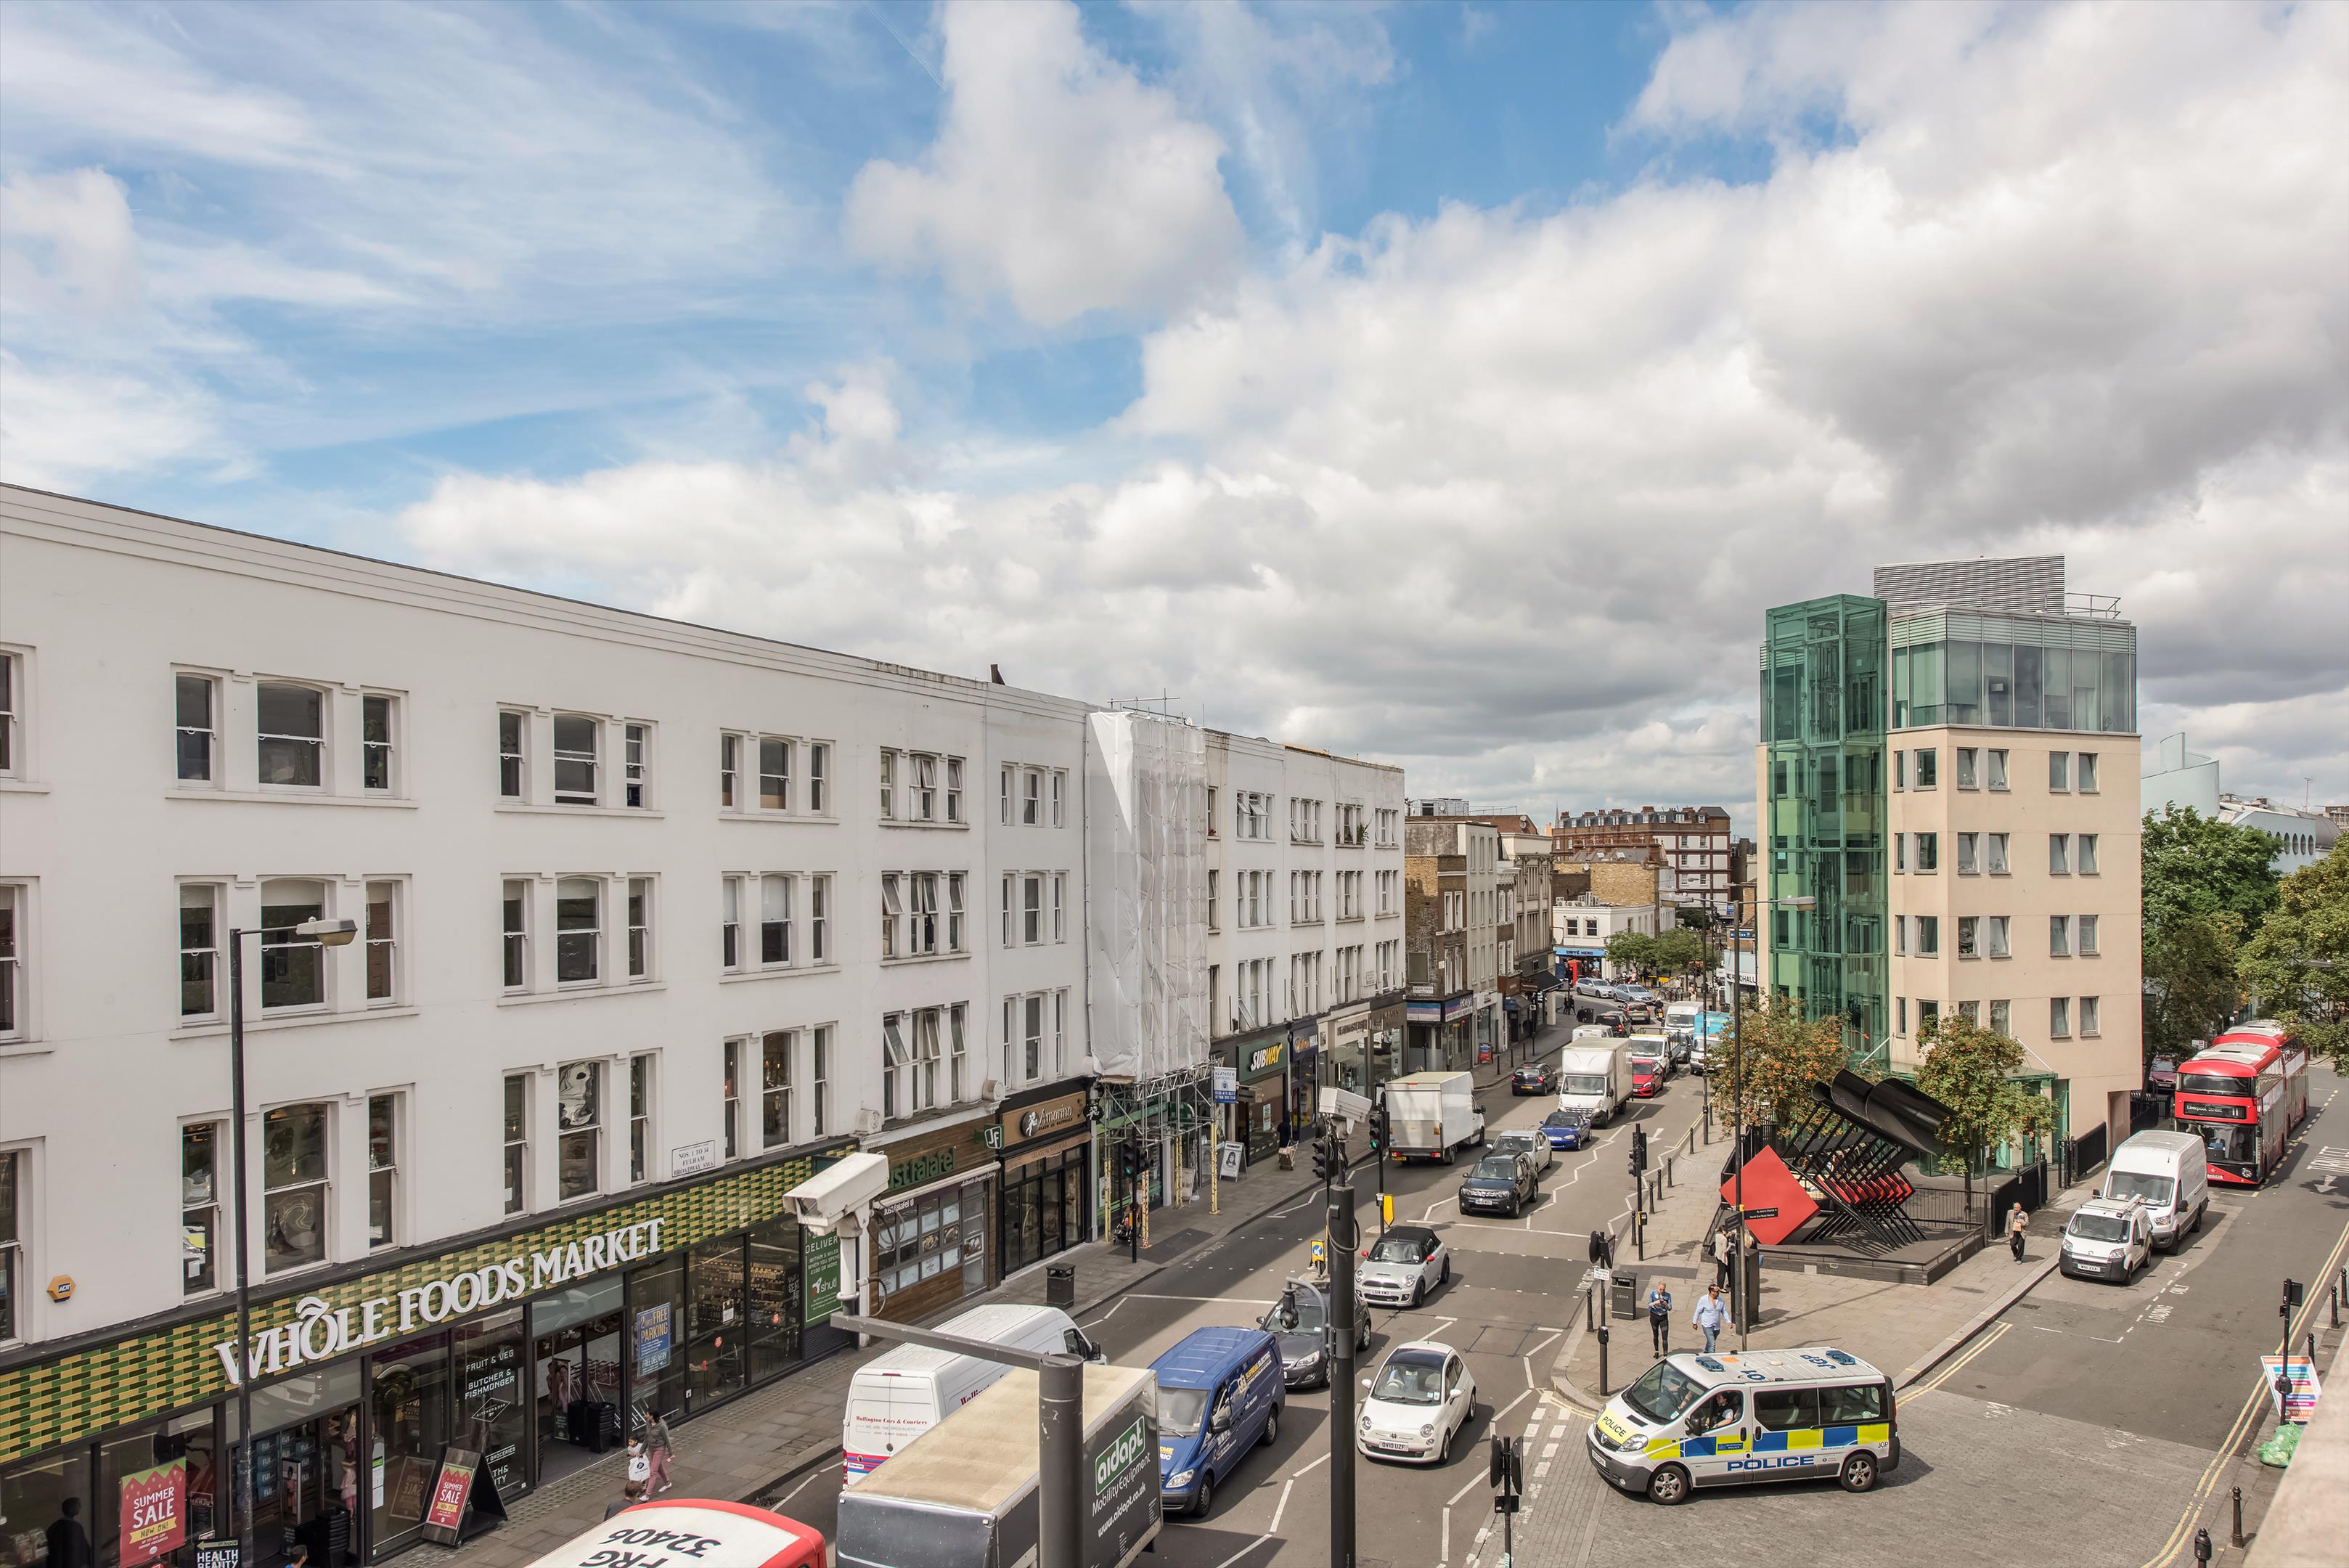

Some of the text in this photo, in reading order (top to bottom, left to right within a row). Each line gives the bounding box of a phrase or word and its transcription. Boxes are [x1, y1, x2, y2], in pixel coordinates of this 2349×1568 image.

[1250, 1042, 1283, 1071] SUBWAY
[1038, 1105, 1072, 1126] Amorino
[674, 1164, 700, 1175] BROADWAY
[682, 1156, 705, 1166] FULHAM
[820, 1278, 836, 1292] shutl
[213, 1217, 665, 1386] WHOLE FOODS MARKET
[653, 1308, 668, 1324] FREE
[641, 1322, 668, 1342] PARKING
[466, 1349, 515, 1373] FRUIT & VEG
[642, 1357, 651, 1368] FREE
[465, 1375, 515, 1400] FISHMONGER
[468, 1371, 504, 1390] BUTCHER
[1602, 1416, 1626, 1437] POLICE
[491, 1446, 515, 1462] GROCERIES
[1097, 1420, 1143, 1485] aidapt
[1727, 1455, 1814, 1471] POLICE
[444, 1482, 462, 1492] SUMMER
[1092, 1452, 1151, 1517] Mobility Equipment
[134, 1486, 174, 1509] SUMMER
[440, 1490, 461, 1504] SALE
[133, 1498, 174, 1529] SALE
[1098, 1482, 1146, 1538] www.aidapt.co.uk
[140, 1522, 168, 1538] NOW ON!
[598, 1529, 722, 1559] 32406
[197, 1549, 238, 1563] HEALTH
[579, 1551, 669, 1568] FRG
